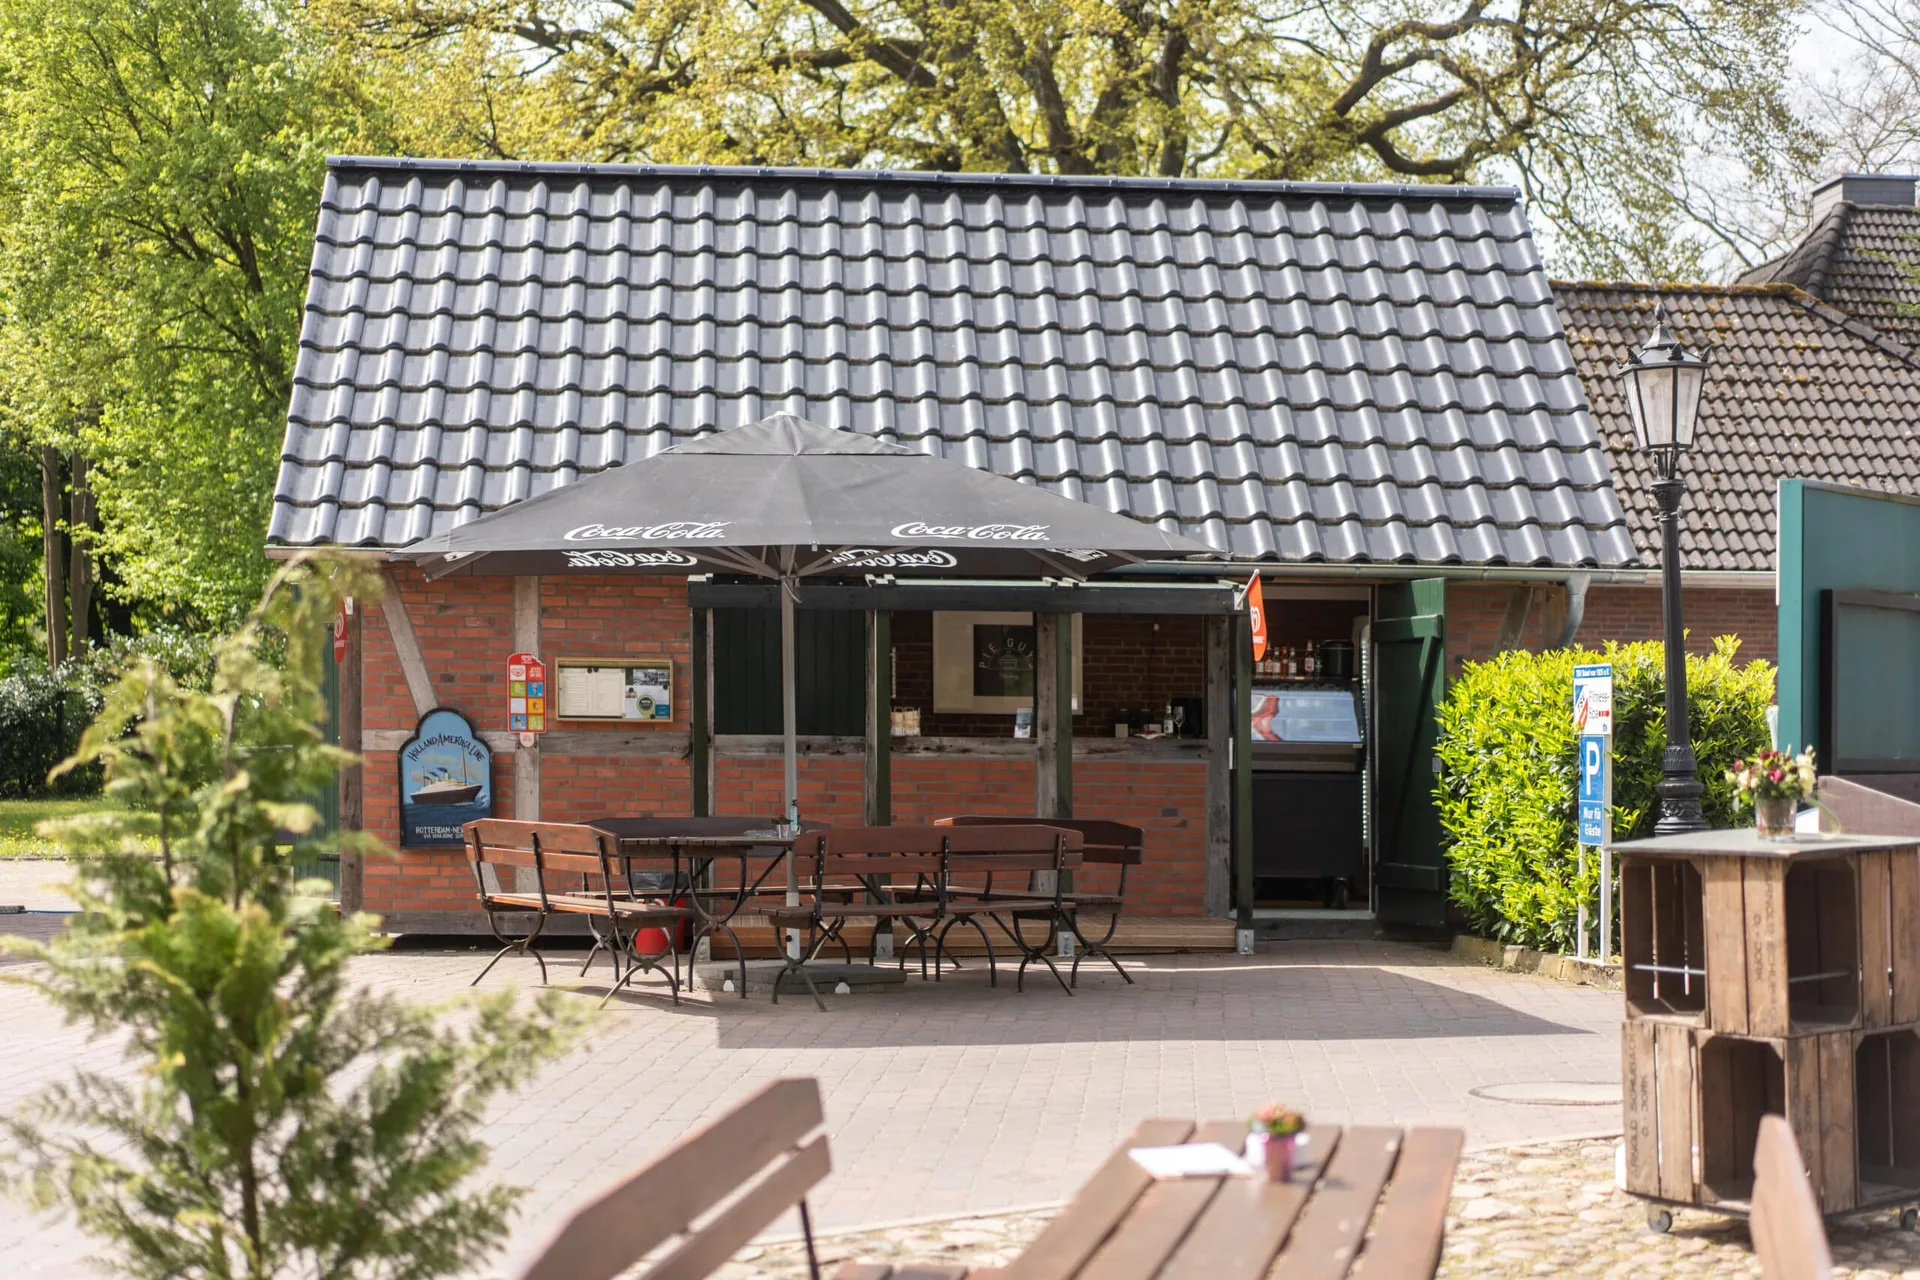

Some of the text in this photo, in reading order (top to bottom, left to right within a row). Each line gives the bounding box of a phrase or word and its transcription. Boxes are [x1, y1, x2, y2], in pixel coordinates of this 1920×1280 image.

[564, 522, 732, 541] Coca-Cola
[891, 522, 1050, 540] Coca-Cola
[978, 643, 997, 669] PIE
[468, 744, 485, 762] LINE
[1586, 741, 1600, 795] P
[1583, 807, 1594, 820] Nur
[1585, 823, 1601, 836] Gäste
[1754, 941, 1763, 982] JORK
[1640, 1075, 1649, 1112] JORK
